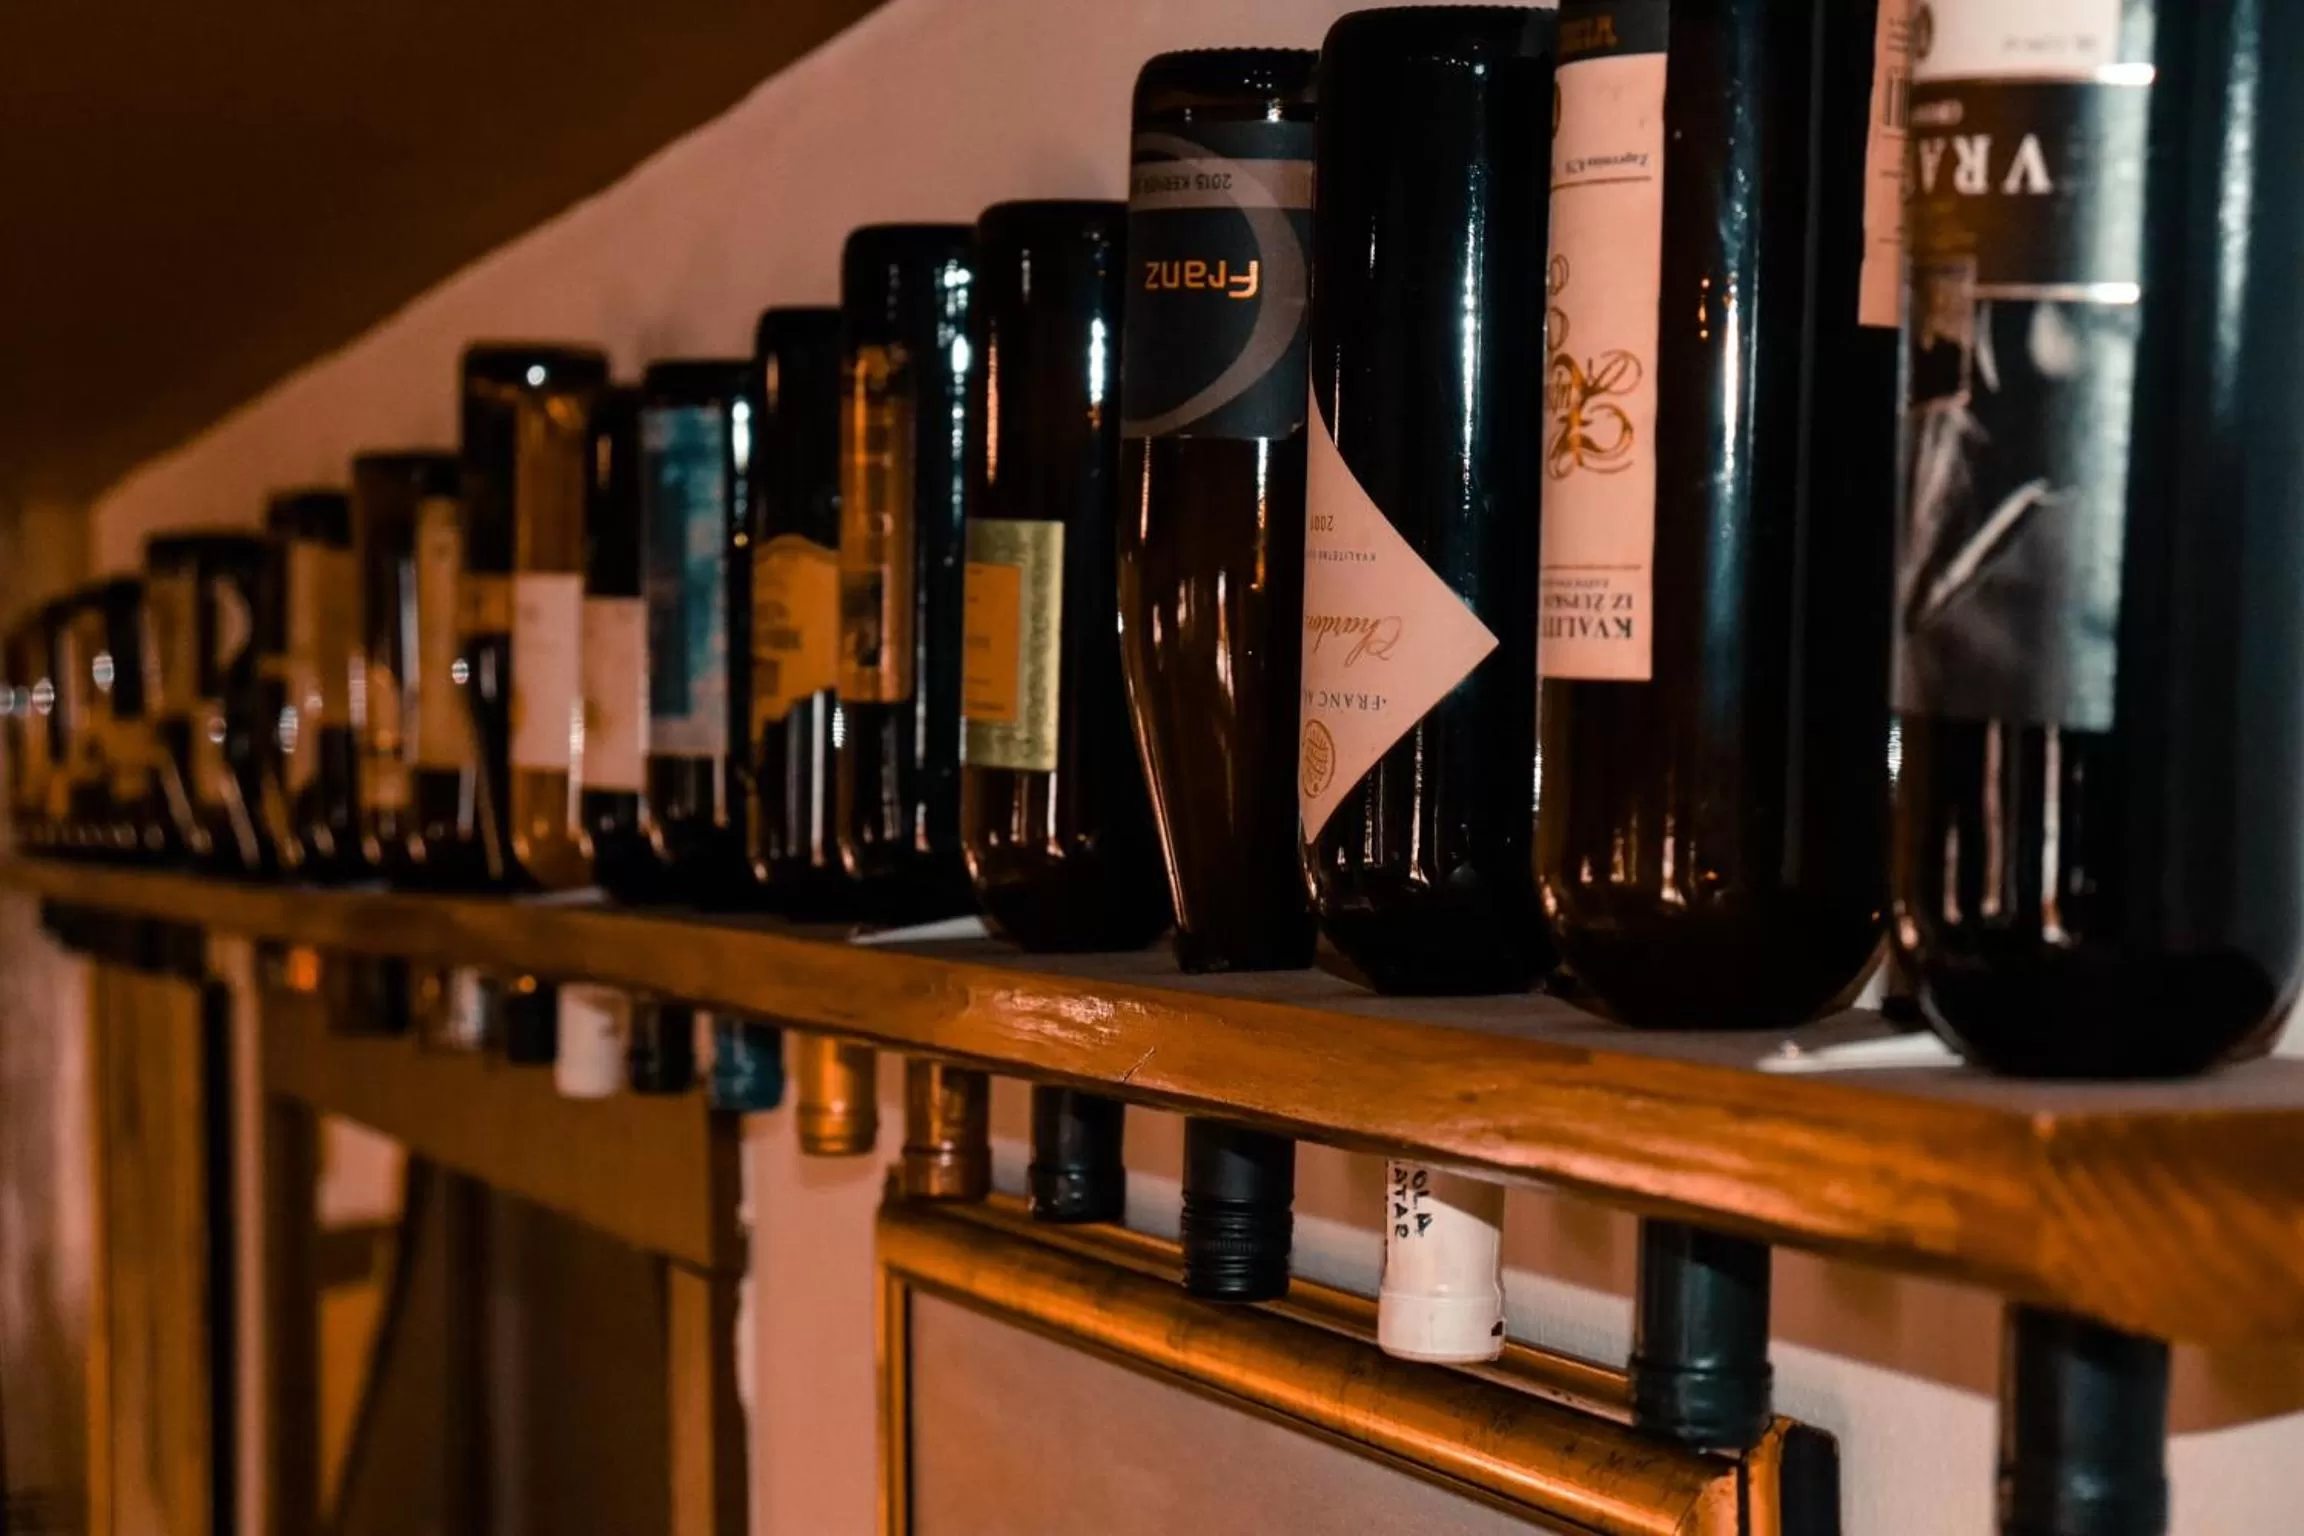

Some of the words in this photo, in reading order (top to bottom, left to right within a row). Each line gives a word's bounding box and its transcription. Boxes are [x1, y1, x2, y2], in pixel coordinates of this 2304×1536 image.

[1195, 172, 1232, 190] 2015
[1911, 133, 2053, 195] VRA
[1144, 259, 1260, 299] Franz
